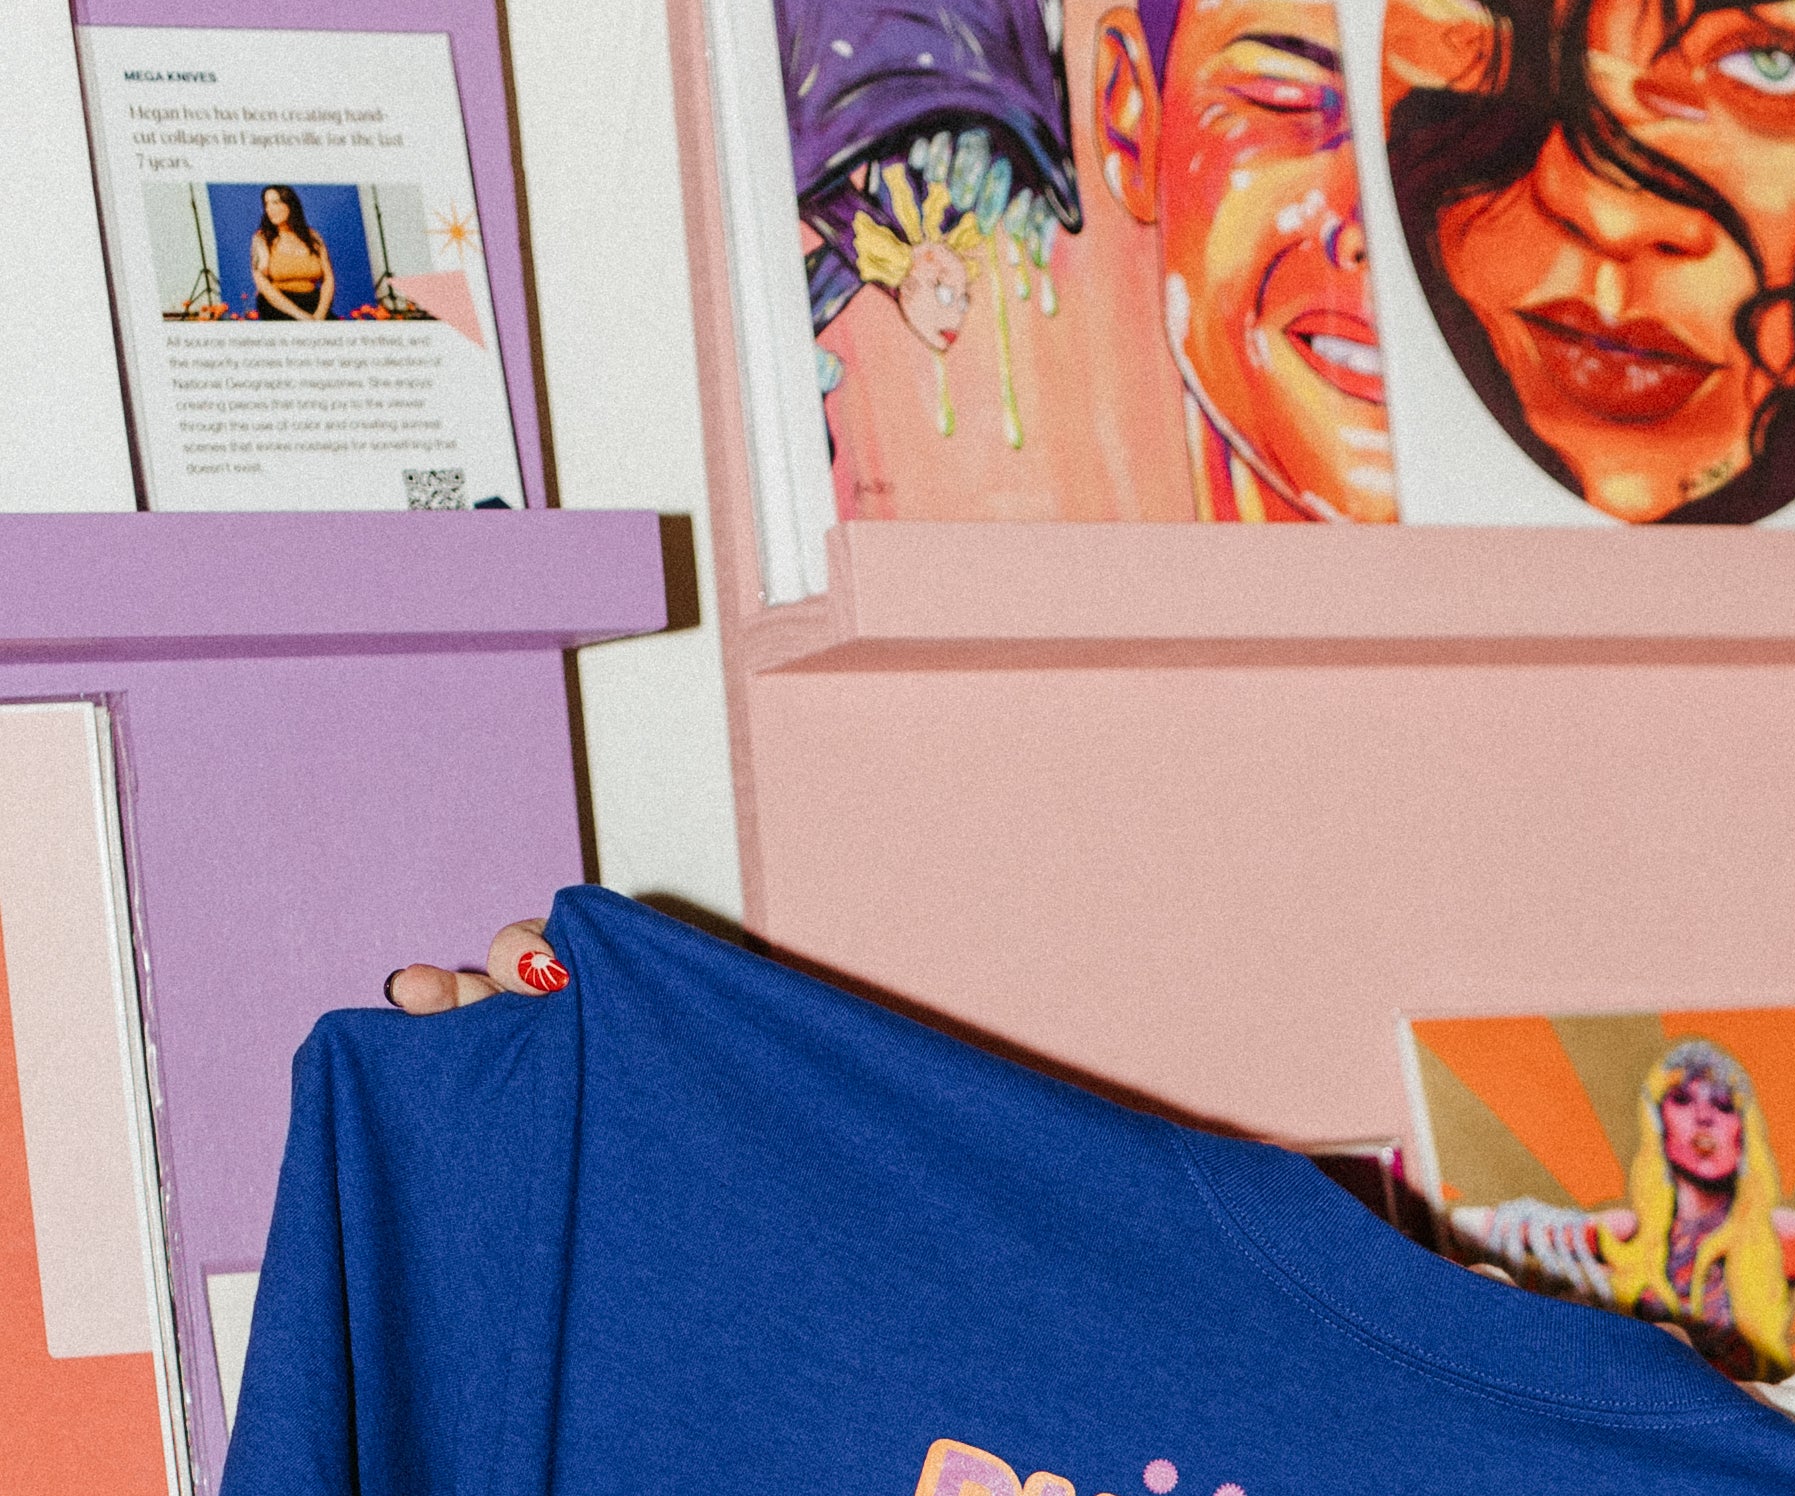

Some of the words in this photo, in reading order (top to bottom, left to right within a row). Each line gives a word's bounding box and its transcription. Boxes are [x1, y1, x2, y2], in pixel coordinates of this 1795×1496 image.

[124, 70, 165, 83] MEGA
[167, 71, 218, 84] KNIVES
[214, 106, 239, 121] has
[243, 106, 278, 121] been
[281, 107, 343, 124] creating
[133, 131, 156, 145] cut
[222, 131, 238, 145] in
[350, 131, 374, 146] the
